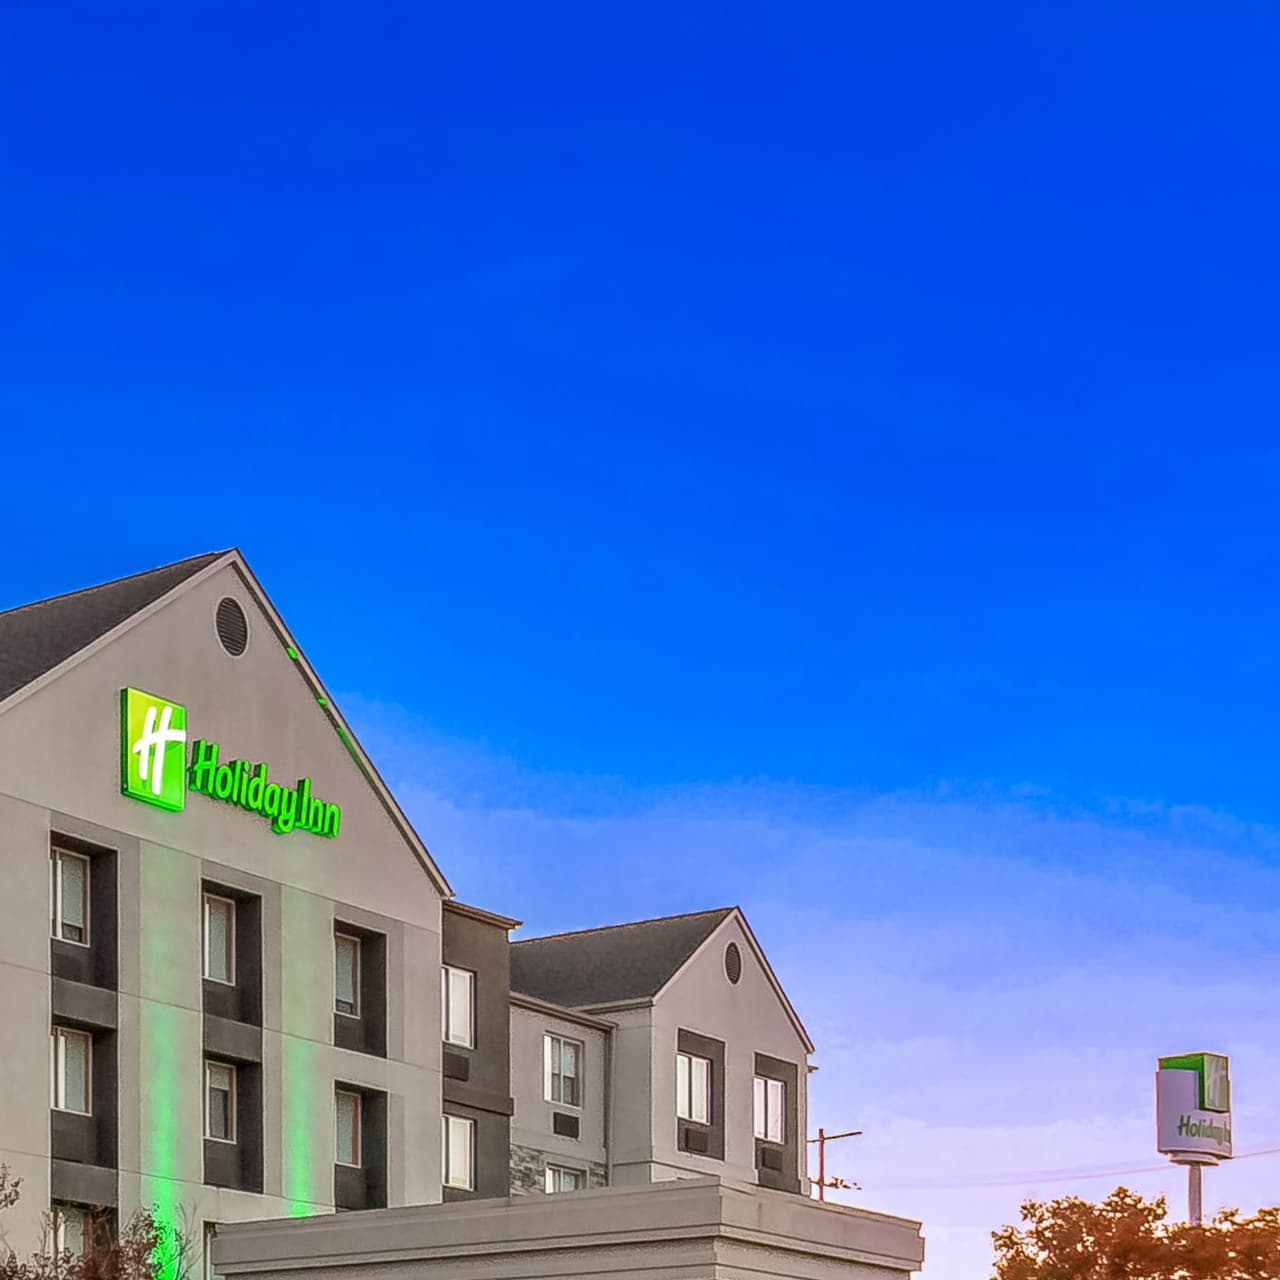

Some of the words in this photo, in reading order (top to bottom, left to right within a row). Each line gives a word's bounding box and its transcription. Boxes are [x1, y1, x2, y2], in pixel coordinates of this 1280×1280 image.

[133, 706, 186, 796] H
[188, 738, 298, 834] Holiday
[297, 777, 340, 838] Inn
